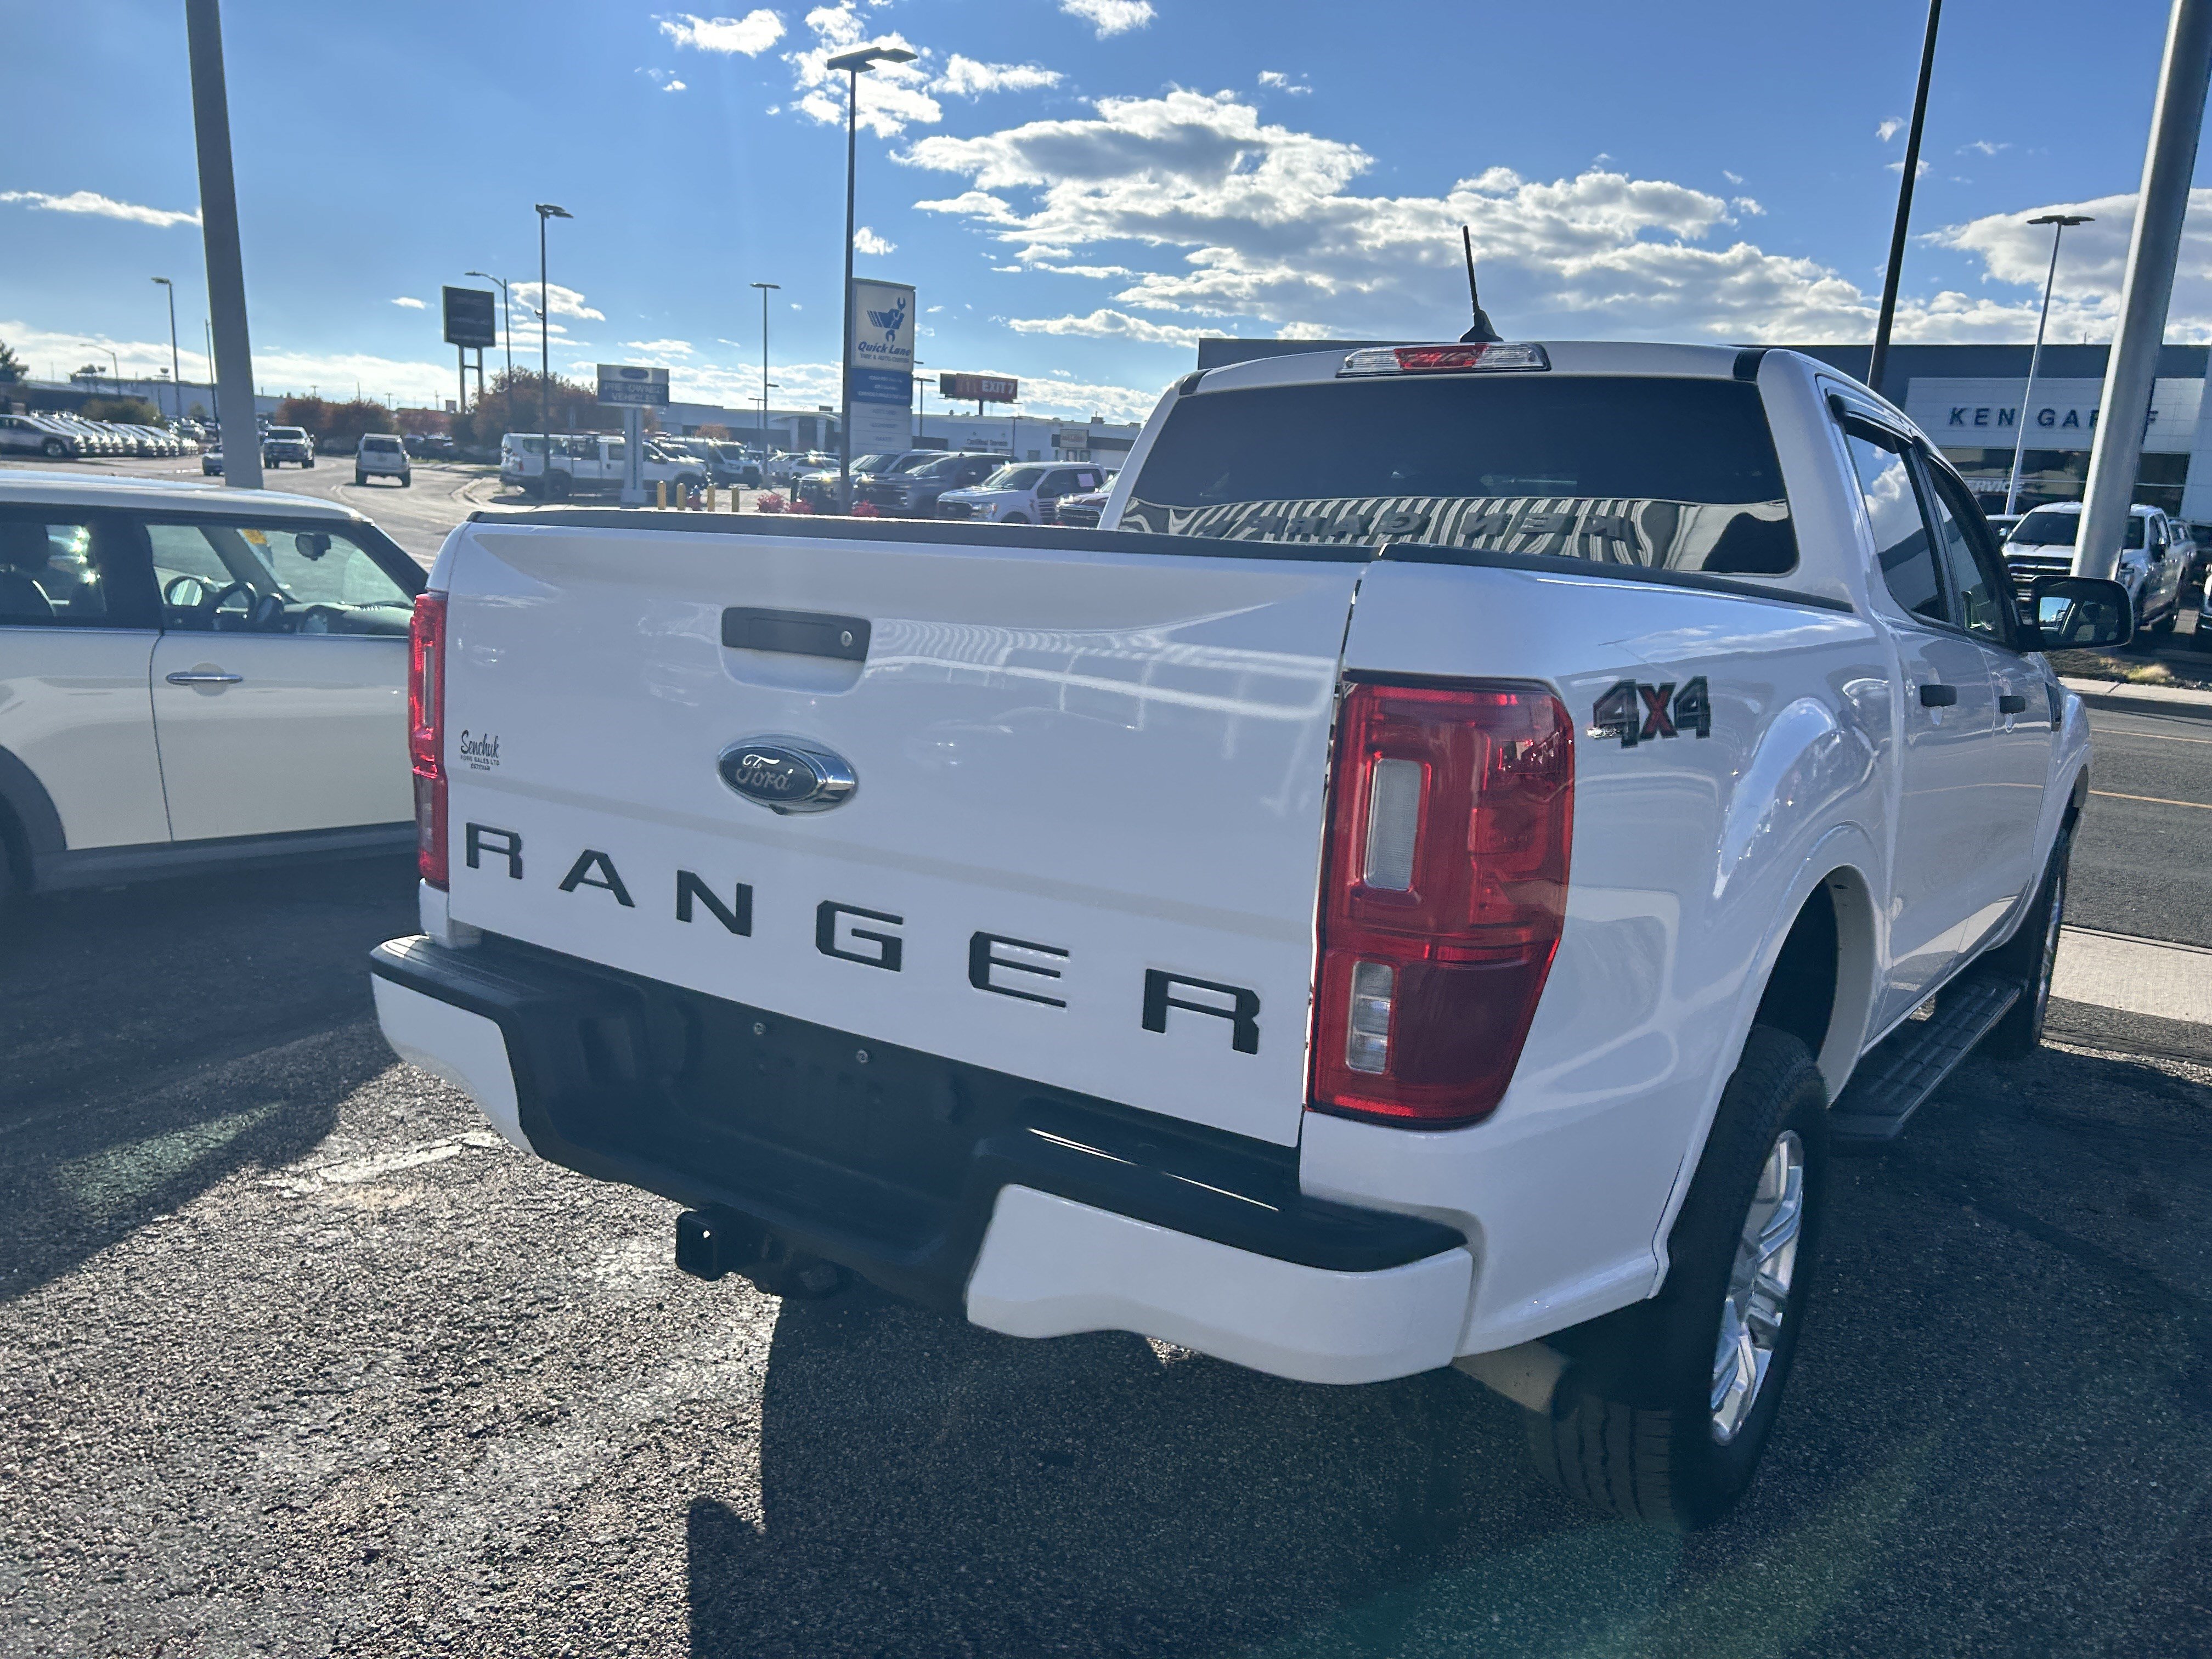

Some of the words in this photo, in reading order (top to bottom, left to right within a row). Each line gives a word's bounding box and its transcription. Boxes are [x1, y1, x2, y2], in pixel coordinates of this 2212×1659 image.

[857, 341, 888, 353] Quick
[889, 345, 911, 356] Lane
[981, 379, 1006, 393] EXIT
[1008, 382, 1014, 394] 7
[1949, 407, 2016, 426] KEN
[736, 754, 797, 791] Ford
[466, 821, 1260, 1055] RANGER
